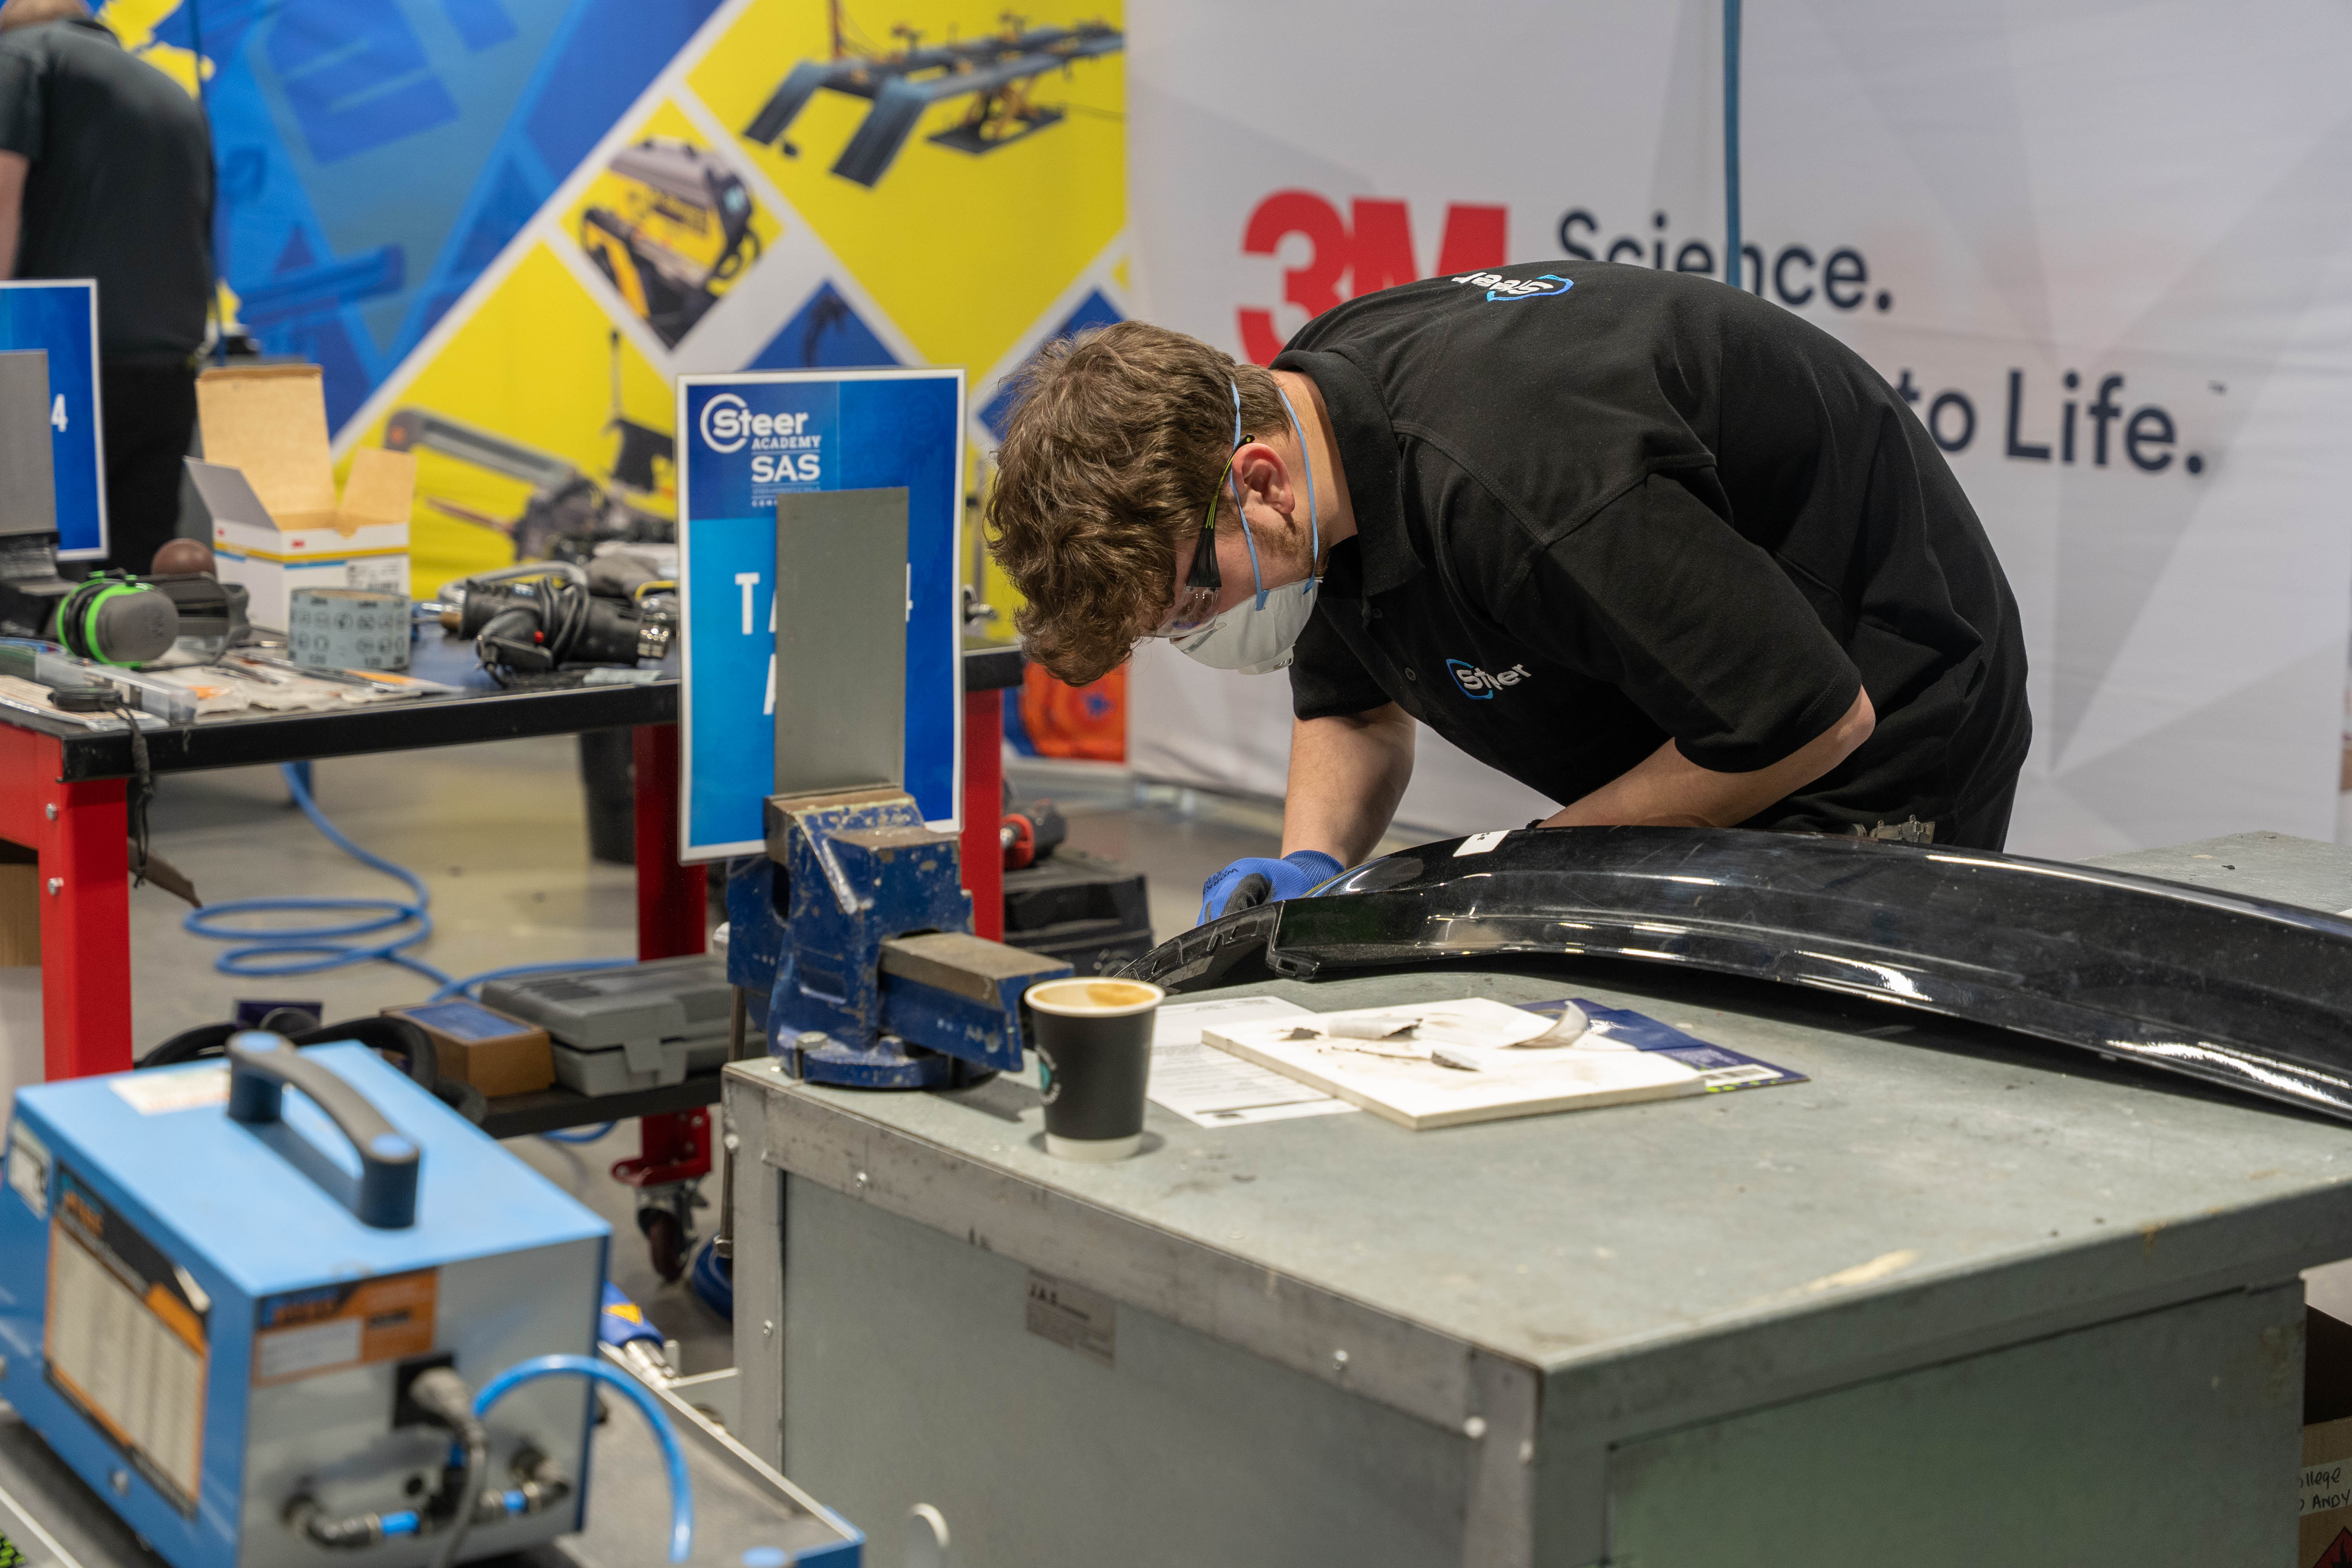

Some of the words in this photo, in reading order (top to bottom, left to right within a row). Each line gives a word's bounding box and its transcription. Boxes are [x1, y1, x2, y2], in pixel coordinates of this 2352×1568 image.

[713, 408, 809, 437] Steer
[2004, 368, 2205, 475] Life.
[751, 435, 822, 450] ACADEMY
[751, 454, 821, 483] SAS
[2313, 1489, 2350, 1509] ANDY
